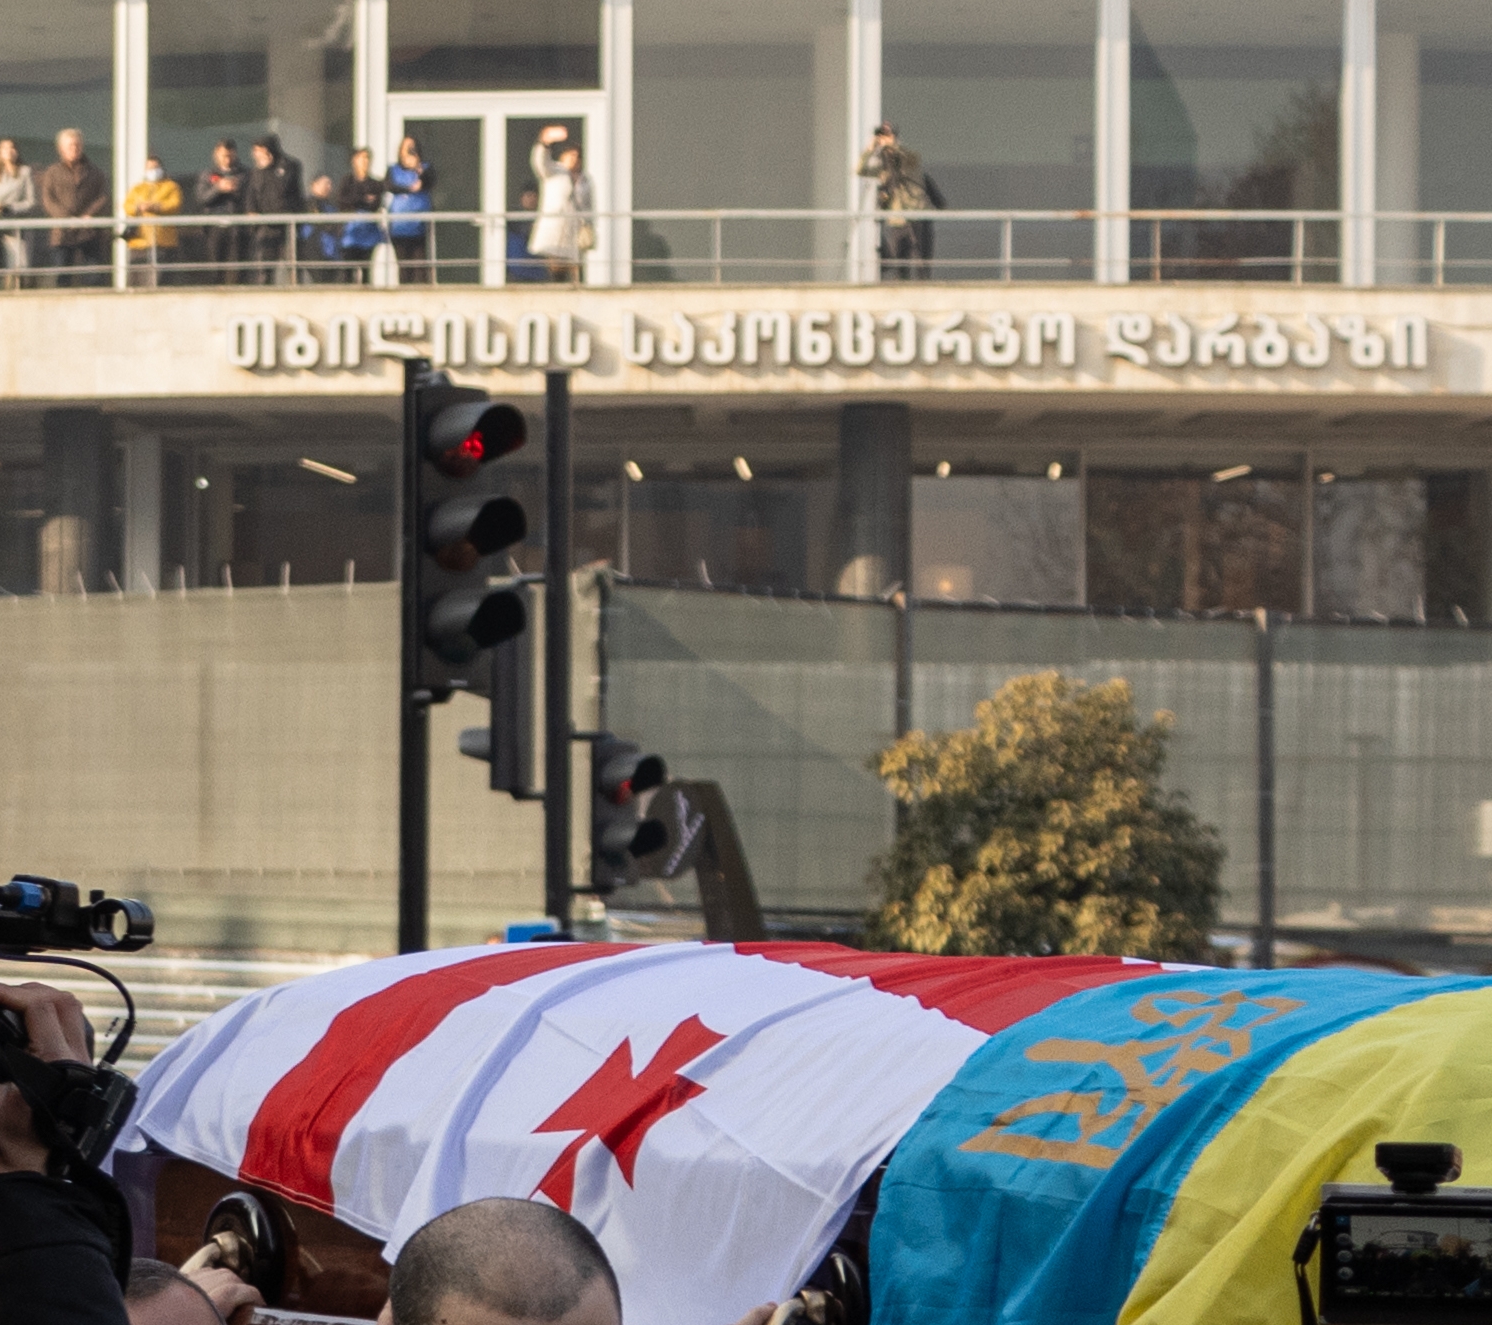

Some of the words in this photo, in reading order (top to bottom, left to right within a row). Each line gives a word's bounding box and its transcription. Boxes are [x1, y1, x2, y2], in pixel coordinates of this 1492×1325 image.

[225, 311, 592, 369] თბილისის
[622, 309, 1076, 368] საკონცერტო
[1104, 310, 1428, 369] დარბაზი
